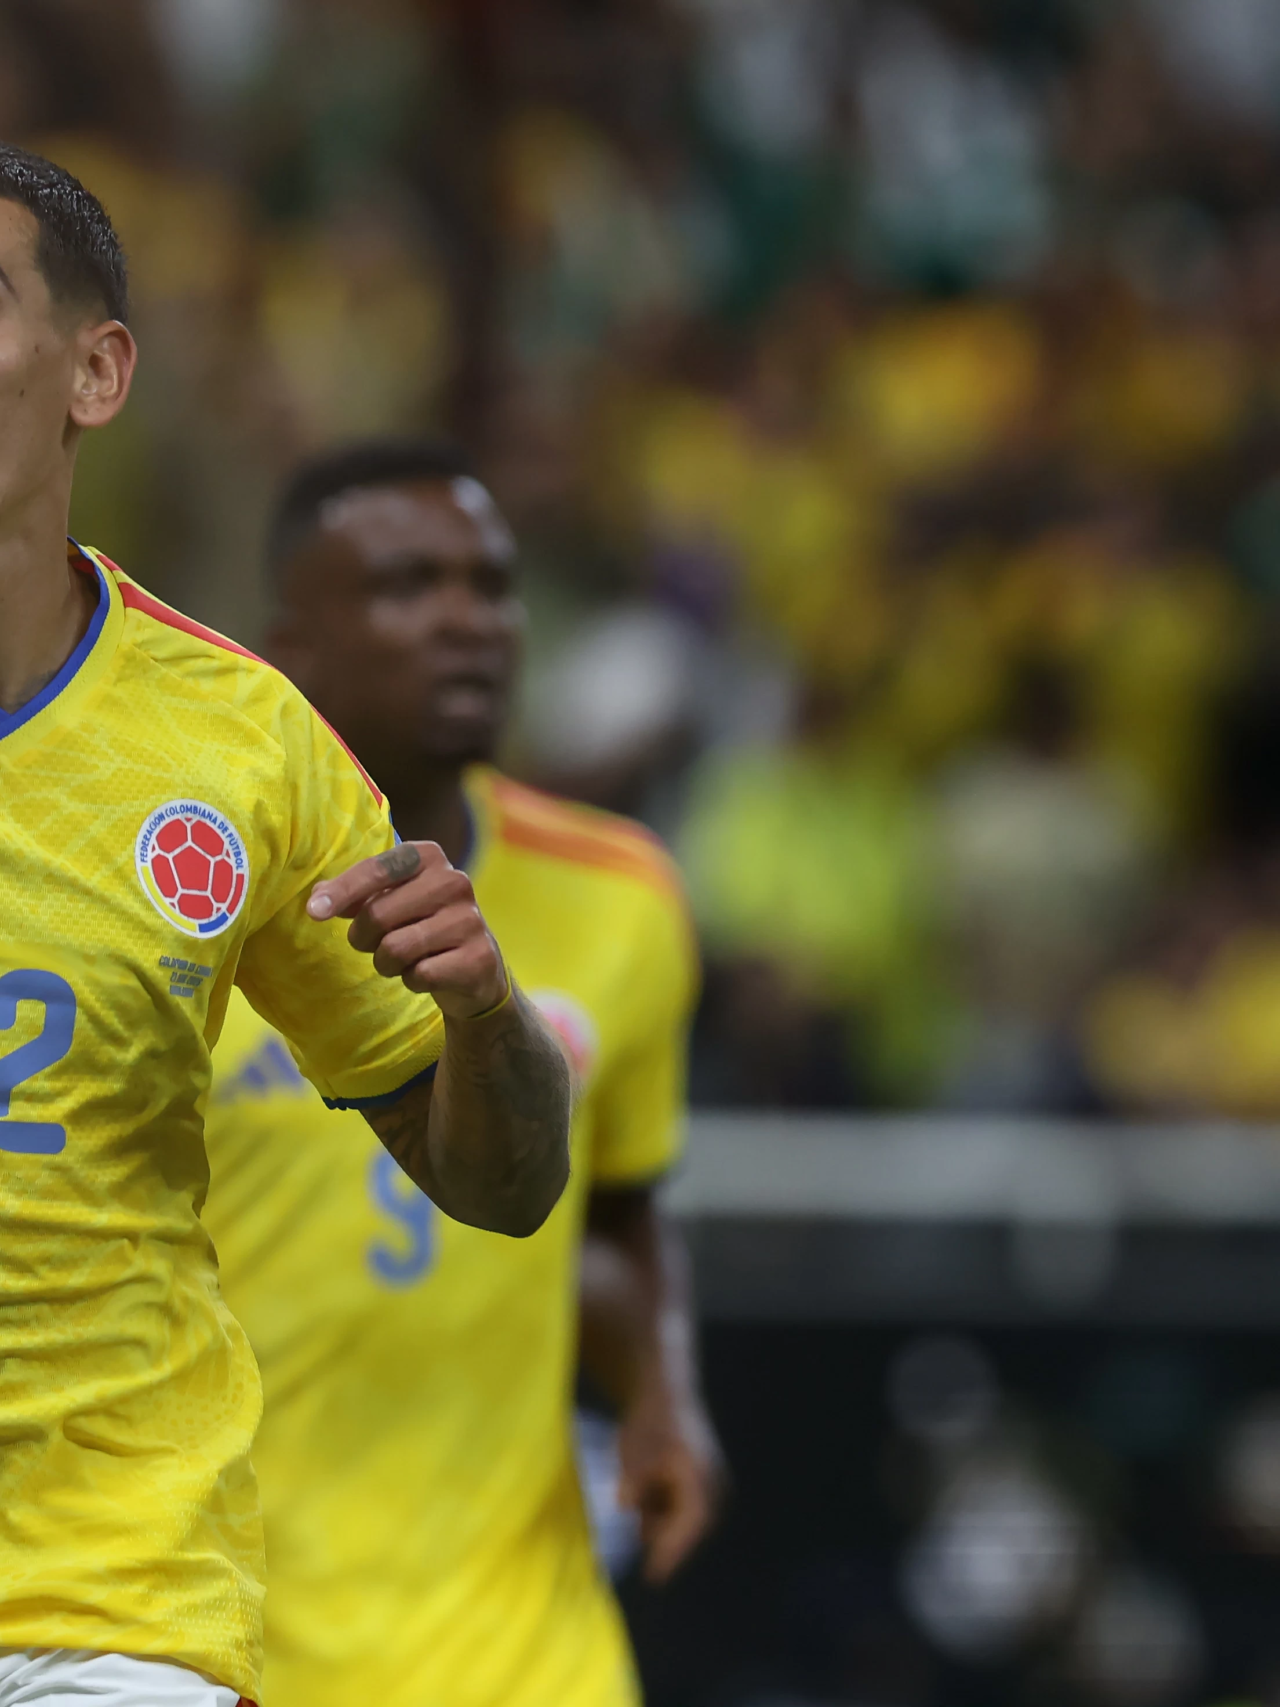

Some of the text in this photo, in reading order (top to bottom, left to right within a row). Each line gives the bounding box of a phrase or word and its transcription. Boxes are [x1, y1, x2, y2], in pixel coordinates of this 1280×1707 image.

[165, 804, 218, 826] COLOMBIANA
[217, 821, 229, 835] DE
[368, 1147, 436, 1287] 9
